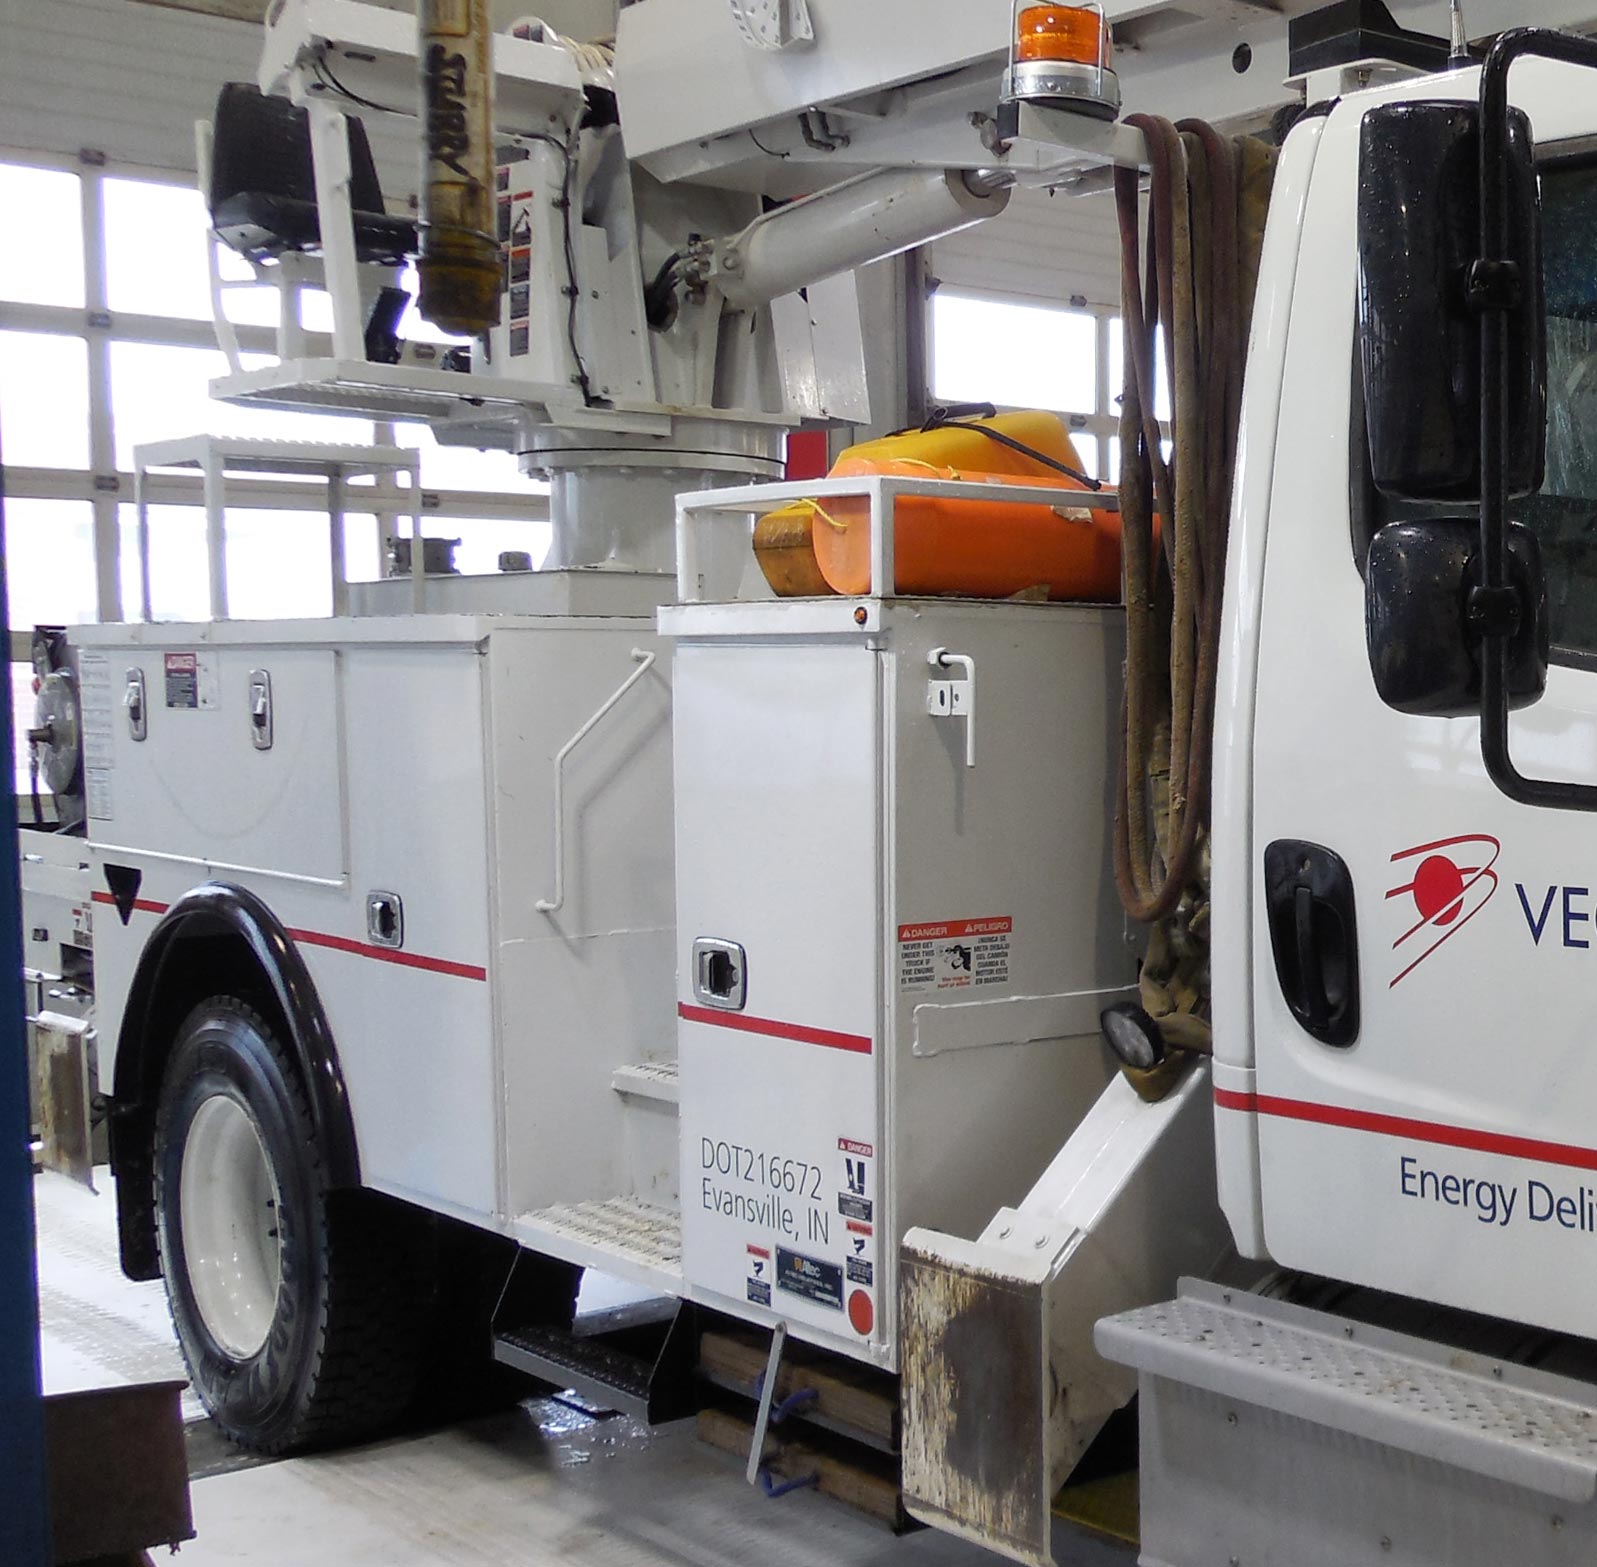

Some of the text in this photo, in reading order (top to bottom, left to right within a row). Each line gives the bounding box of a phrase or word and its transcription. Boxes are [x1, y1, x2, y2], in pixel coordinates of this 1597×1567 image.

[911, 927, 947, 938] DANGER
[974, 921, 1008, 932] PELIGRO
[702, 1136, 822, 1201] DOT216672
[847, 1141, 872, 1156] DANGER
[702, 1177, 799, 1242] Evansville,
[807, 1207, 829, 1245] IN
[1400, 1156, 1517, 1226] Energy
